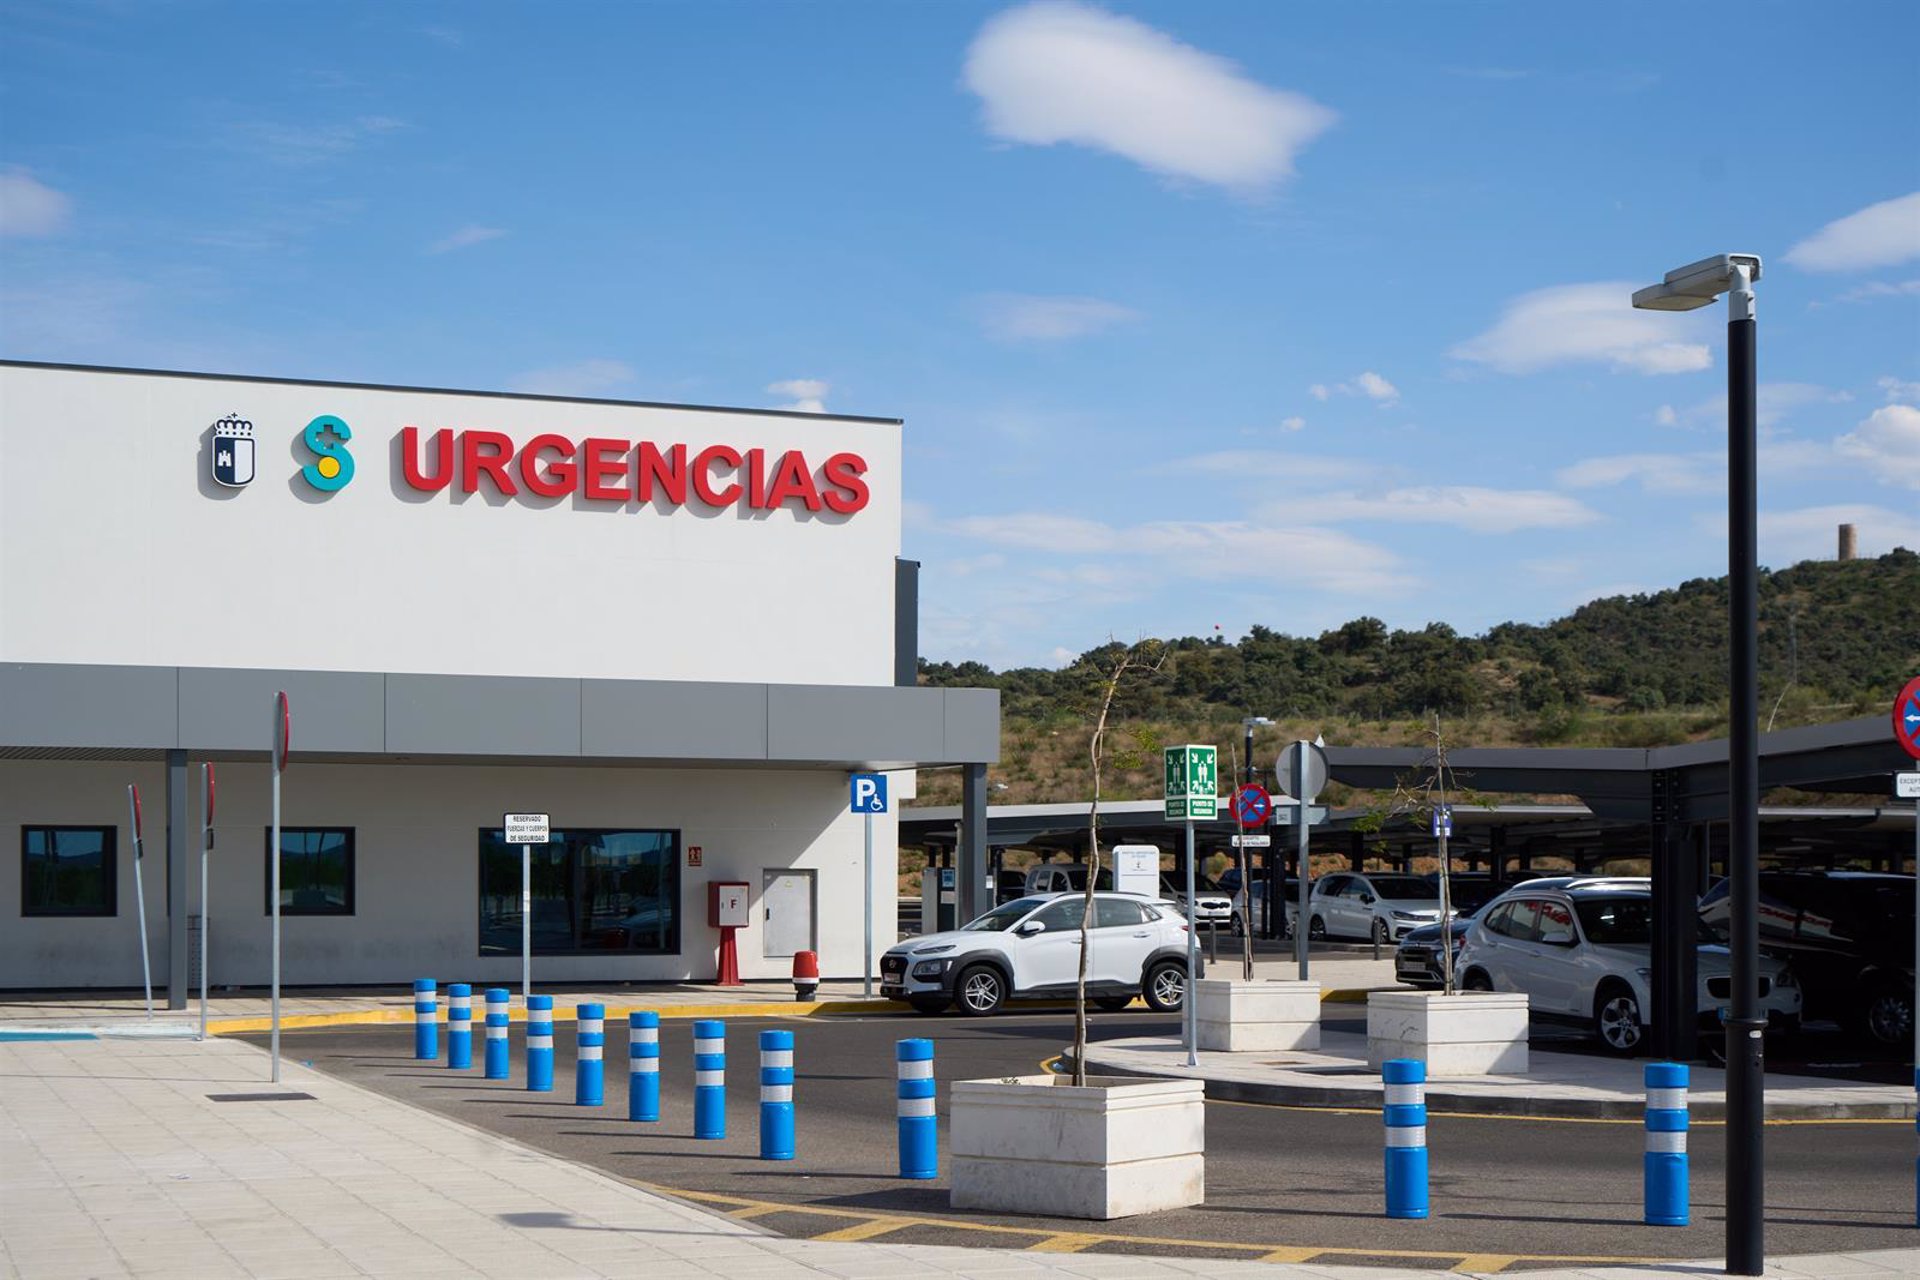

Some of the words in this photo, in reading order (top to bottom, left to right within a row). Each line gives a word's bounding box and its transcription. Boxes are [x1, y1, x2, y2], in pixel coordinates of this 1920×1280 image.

[401, 426, 870, 514] URGENCIAS
[857, 779, 876, 807] P
[513, 815, 542, 823] RESERVADO
[730, 899, 737, 909] F
